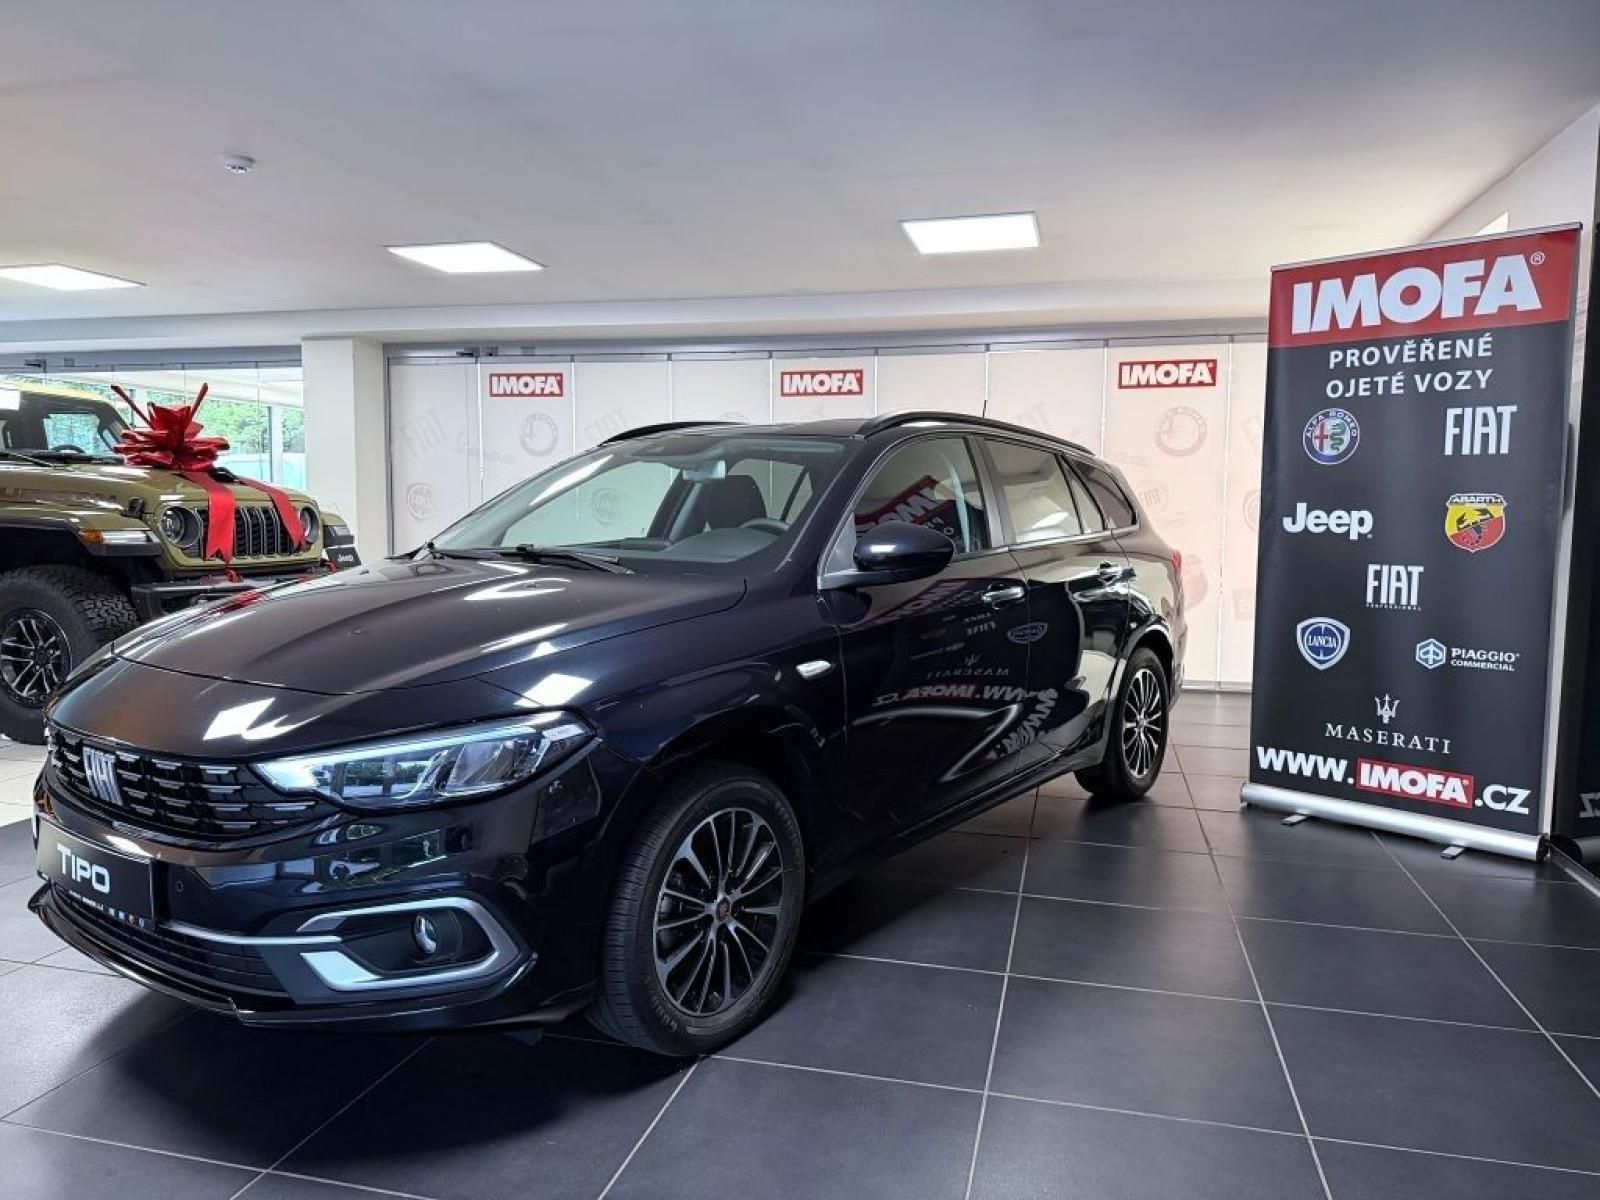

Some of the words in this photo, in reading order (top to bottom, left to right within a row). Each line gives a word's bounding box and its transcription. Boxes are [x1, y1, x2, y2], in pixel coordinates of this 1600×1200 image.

[1292, 254, 1541, 334] IMOFA
[1329, 333, 1493, 369] PROVĚŘENÉ
[491, 375, 561, 396] IMOFA
[782, 371, 861, 395] IMOFA
[1121, 362, 1214, 387] IMOFA
[1326, 372, 1405, 399] OJETÉ
[1415, 368, 1493, 392] VOZY
[1444, 405, 1517, 455] FIAT
[1282, 502, 1373, 540] Jeep
[1366, 563, 1424, 606] FIAT
[1308, 635, 1337, 649] LANCIA
[1451, 647, 1516, 663] PIAGGIO
[1451, 659, 1515, 672] COMMERCIAL
[1324, 722, 1451, 754] MASERATI
[83, 746, 123, 806] FIAT
[57, 842, 110, 894] TIPO
